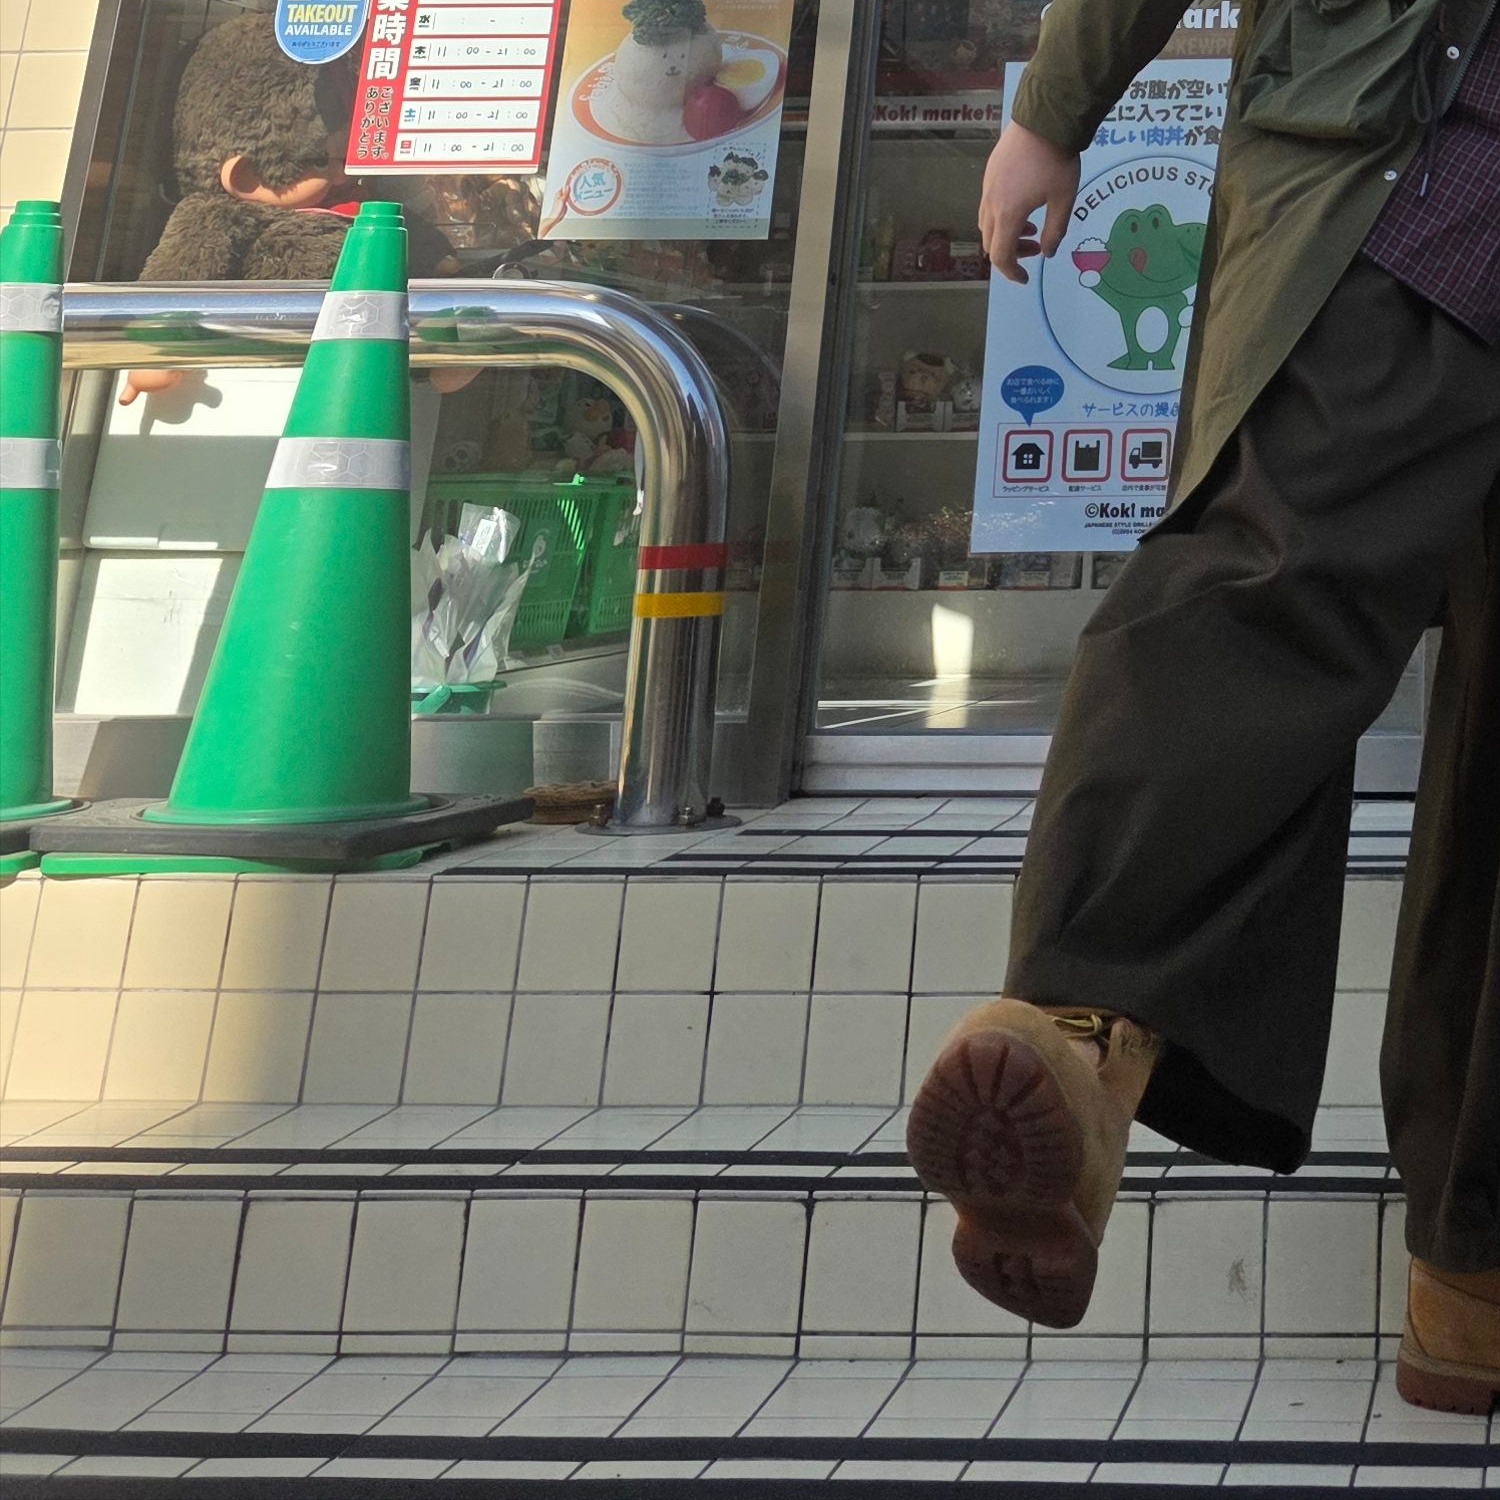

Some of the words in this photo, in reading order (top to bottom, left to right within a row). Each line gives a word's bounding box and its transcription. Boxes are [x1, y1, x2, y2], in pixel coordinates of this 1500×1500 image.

[285, 3, 359, 24] TAKEOUT
[1177, 0, 1241, 30] ark
[283, 24, 353, 37] AVAILABLE
[875, 103, 918, 122] Koki
[922, 102, 997, 122] market
[1073, 165, 1179, 223] DELICIOUS
